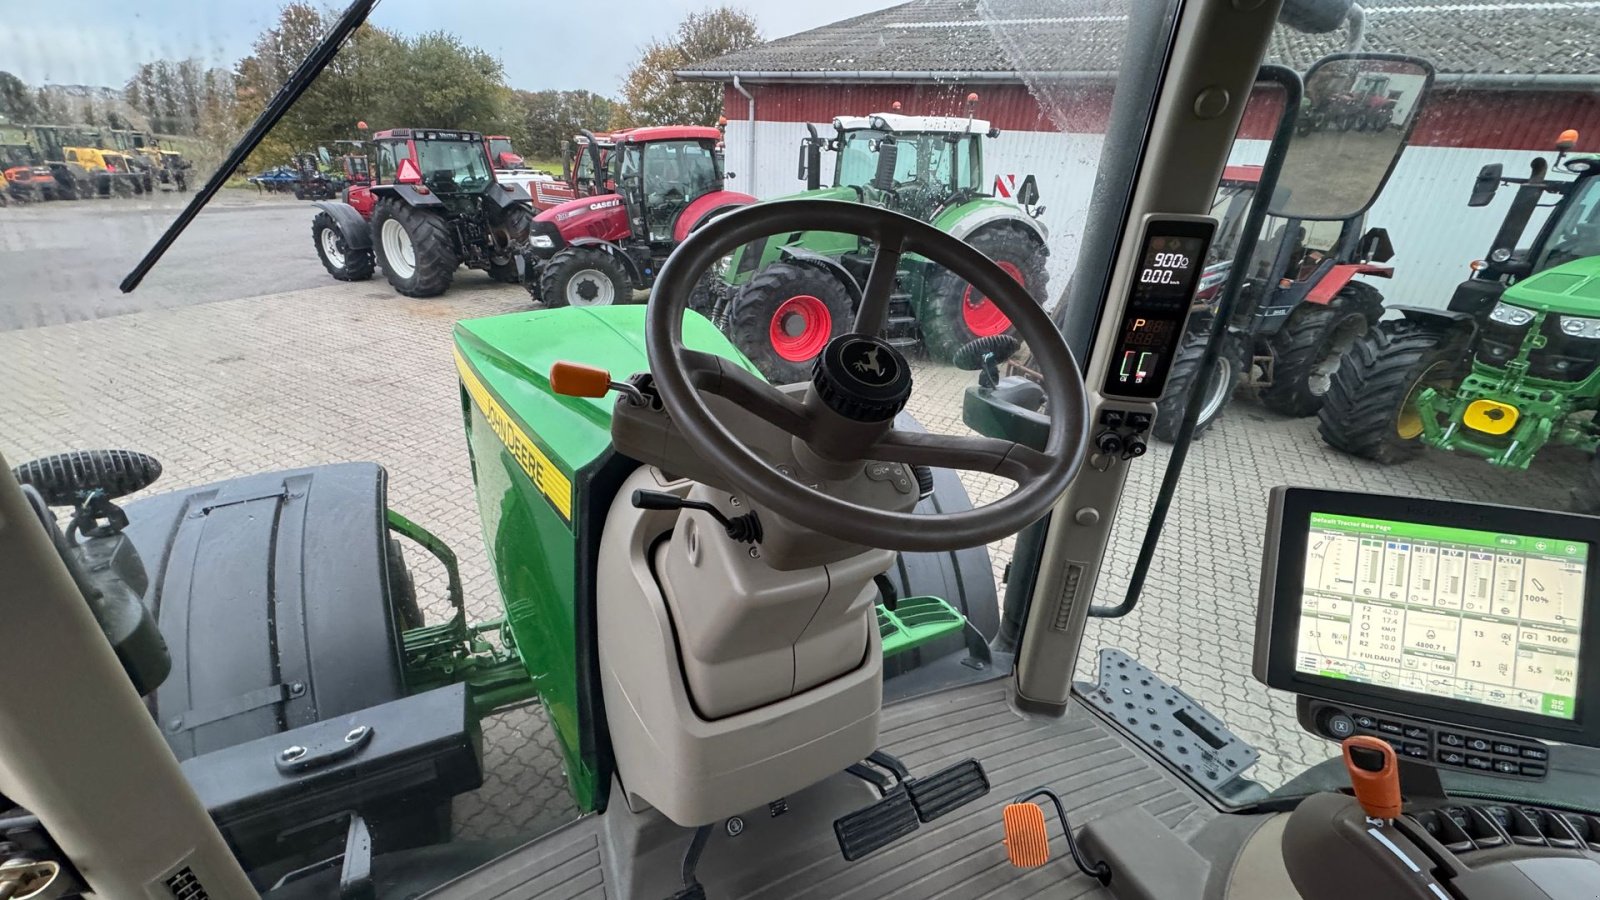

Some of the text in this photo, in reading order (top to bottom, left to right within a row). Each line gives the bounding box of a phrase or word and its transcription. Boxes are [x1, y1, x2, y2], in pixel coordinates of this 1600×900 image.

[1153, 252, 1183, 268] 900
[1132, 318, 1146, 332] P
[487, 398, 544, 489] JOHN DEERE
[1312, 517, 1336, 526] Default
[1525, 594, 1549, 604] 100%
[1360, 652, 1400, 664] FULDAUTO
